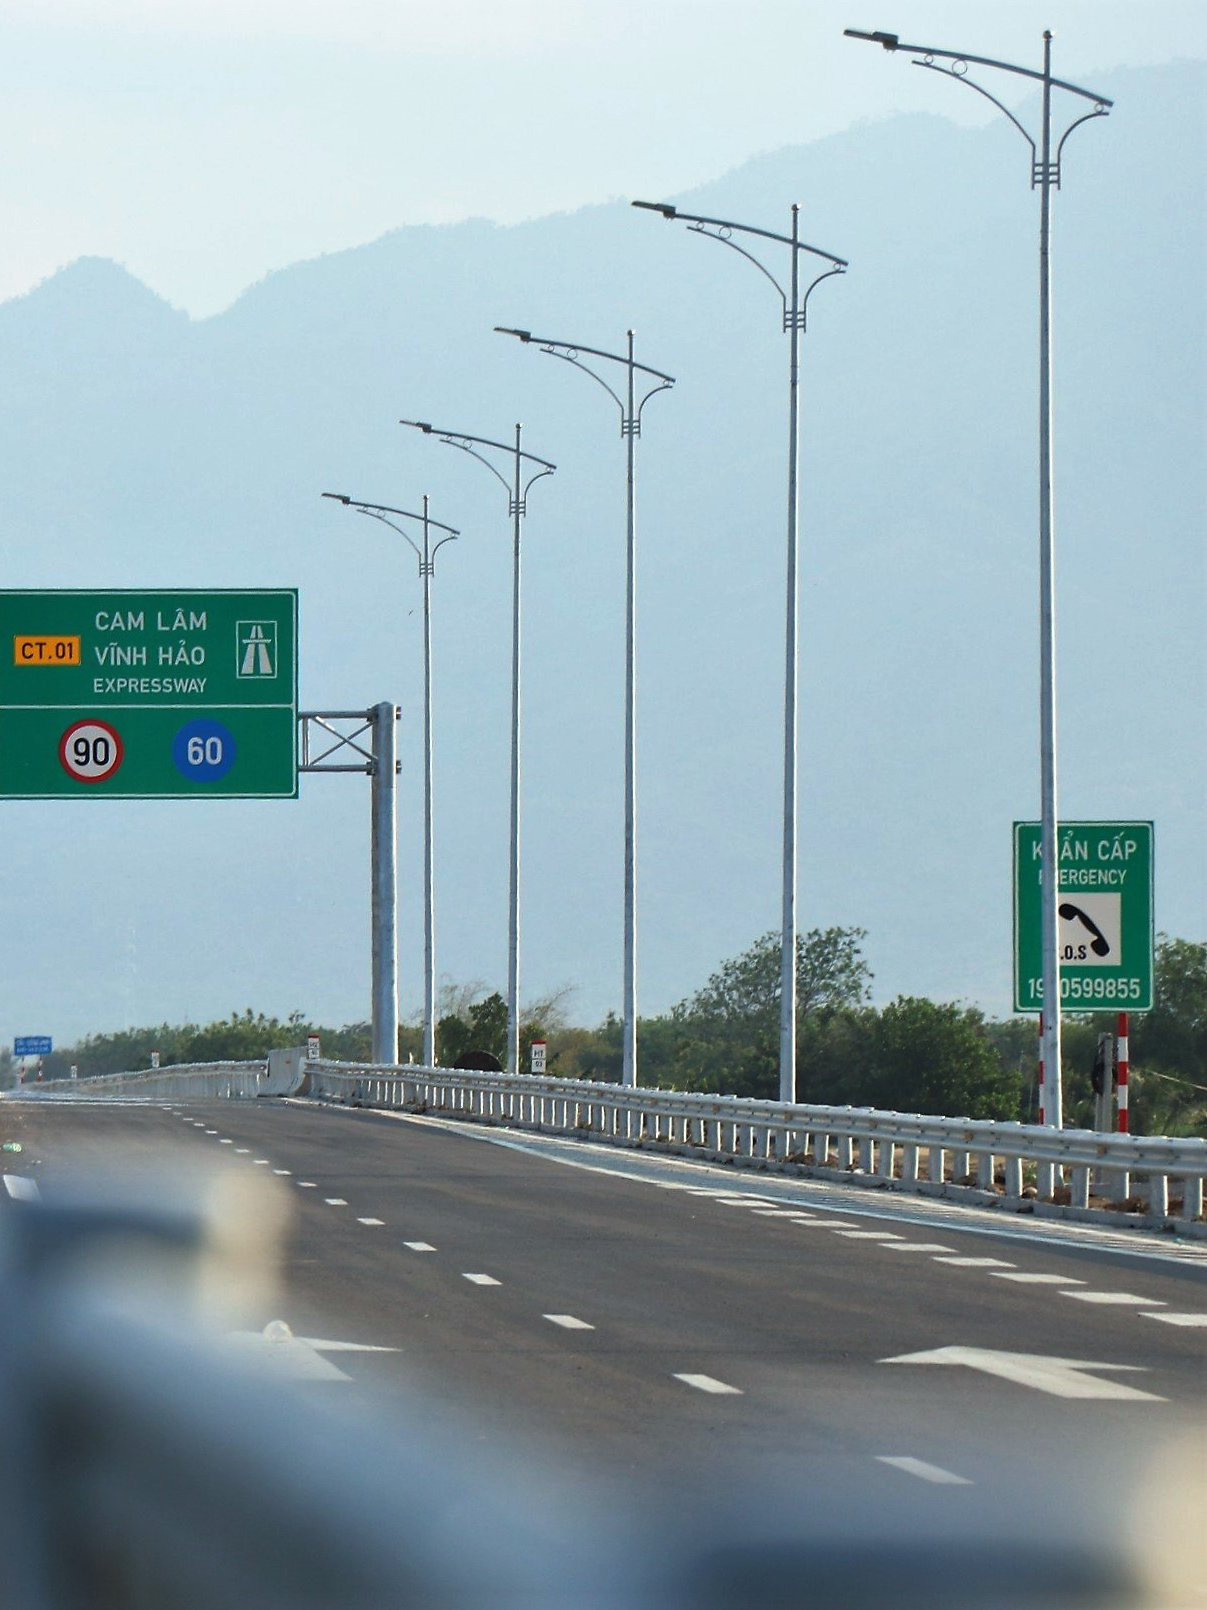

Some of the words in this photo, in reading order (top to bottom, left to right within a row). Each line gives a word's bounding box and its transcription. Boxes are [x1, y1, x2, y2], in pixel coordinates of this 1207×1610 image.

[95, 611, 144, 631] CAM
[157, 608, 207, 631] LÂM
[21, 642, 74, 660] CT.01
[95, 642, 147, 666] VĨNH
[158, 640, 205, 666] HẢO
[94, 678, 207, 693] EXPRESSWAY
[73, 737, 110, 767] 90
[187, 736, 222, 766] 60
[1032, 830, 1088, 860] KẨN
[1097, 831, 1137, 860] CẤP
[1038, 869, 1127, 885] ERGENCY
[1060, 945, 1087, 960] .O.S
[1028, 978, 1141, 999] 190599855
